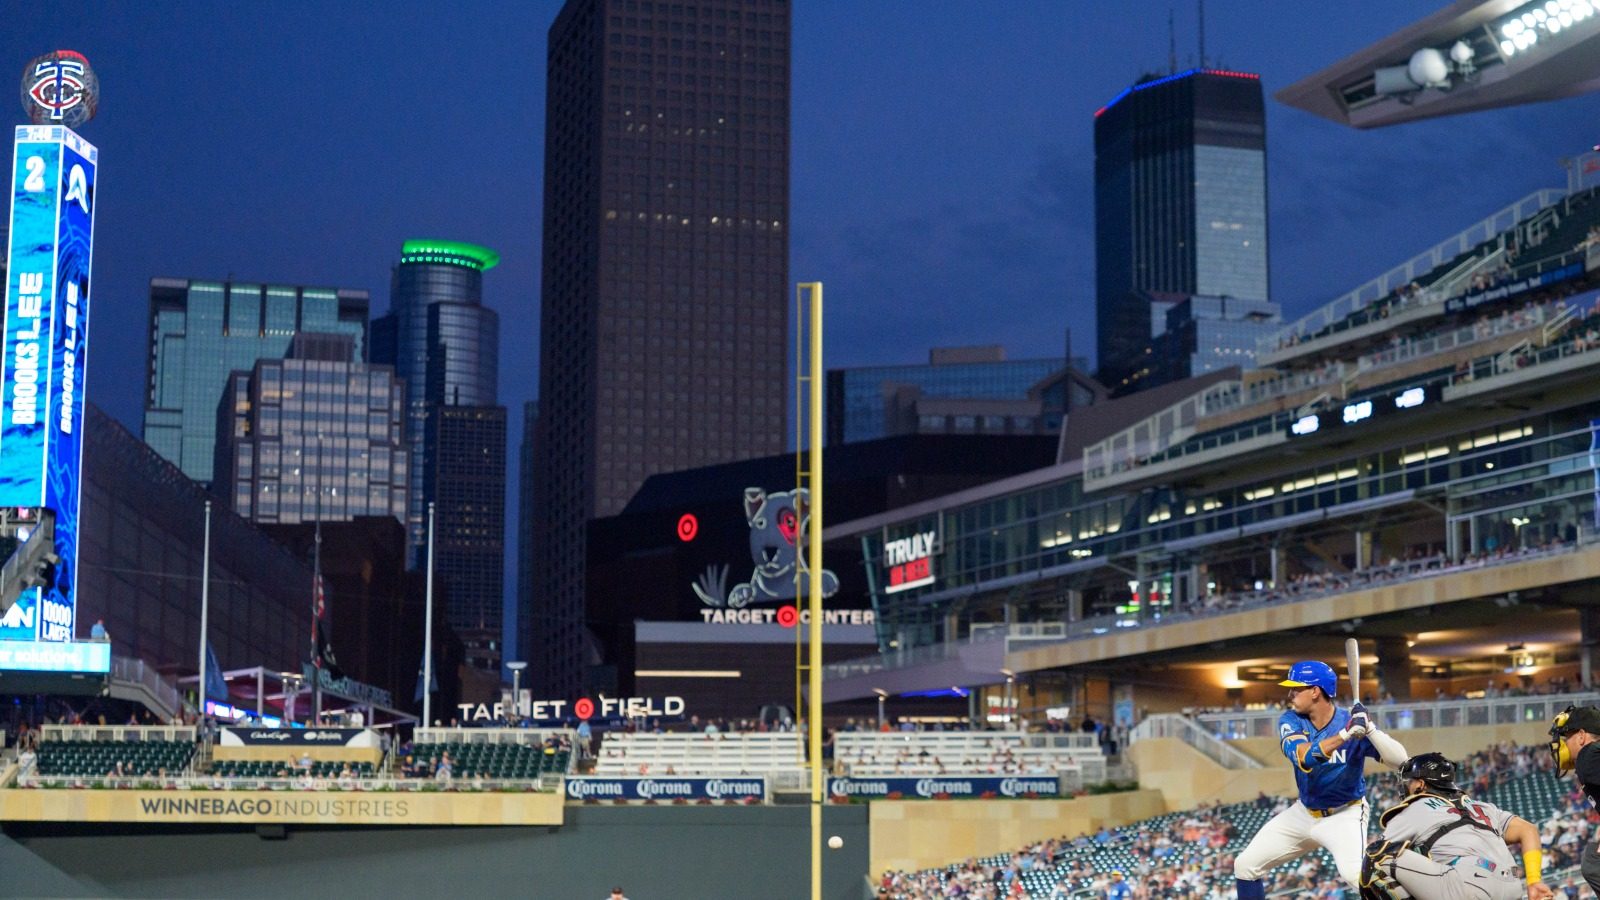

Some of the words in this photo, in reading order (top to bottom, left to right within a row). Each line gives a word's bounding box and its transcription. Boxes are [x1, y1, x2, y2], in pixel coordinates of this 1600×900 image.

[24, 156, 45, 192] 2
[16, 272, 43, 340] LEE
[12, 342, 40, 424] BROOKS
[885, 531, 935, 566] TRULY
[701, 609, 776, 625] TARGET
[457, 700, 567, 721] TARET
[601, 696, 685, 717] FIELD
[568, 779, 622, 799] Corona
[636, 779, 692, 798] Corona
[705, 779, 762, 798] Corona
[831, 779, 888, 797] Corona
[915, 779, 972, 797] Corona
[999, 778, 1056, 797] Corona
[140, 798, 272, 816] WINNEBAGO
[273, 800, 409, 816] INDUSTRIES
